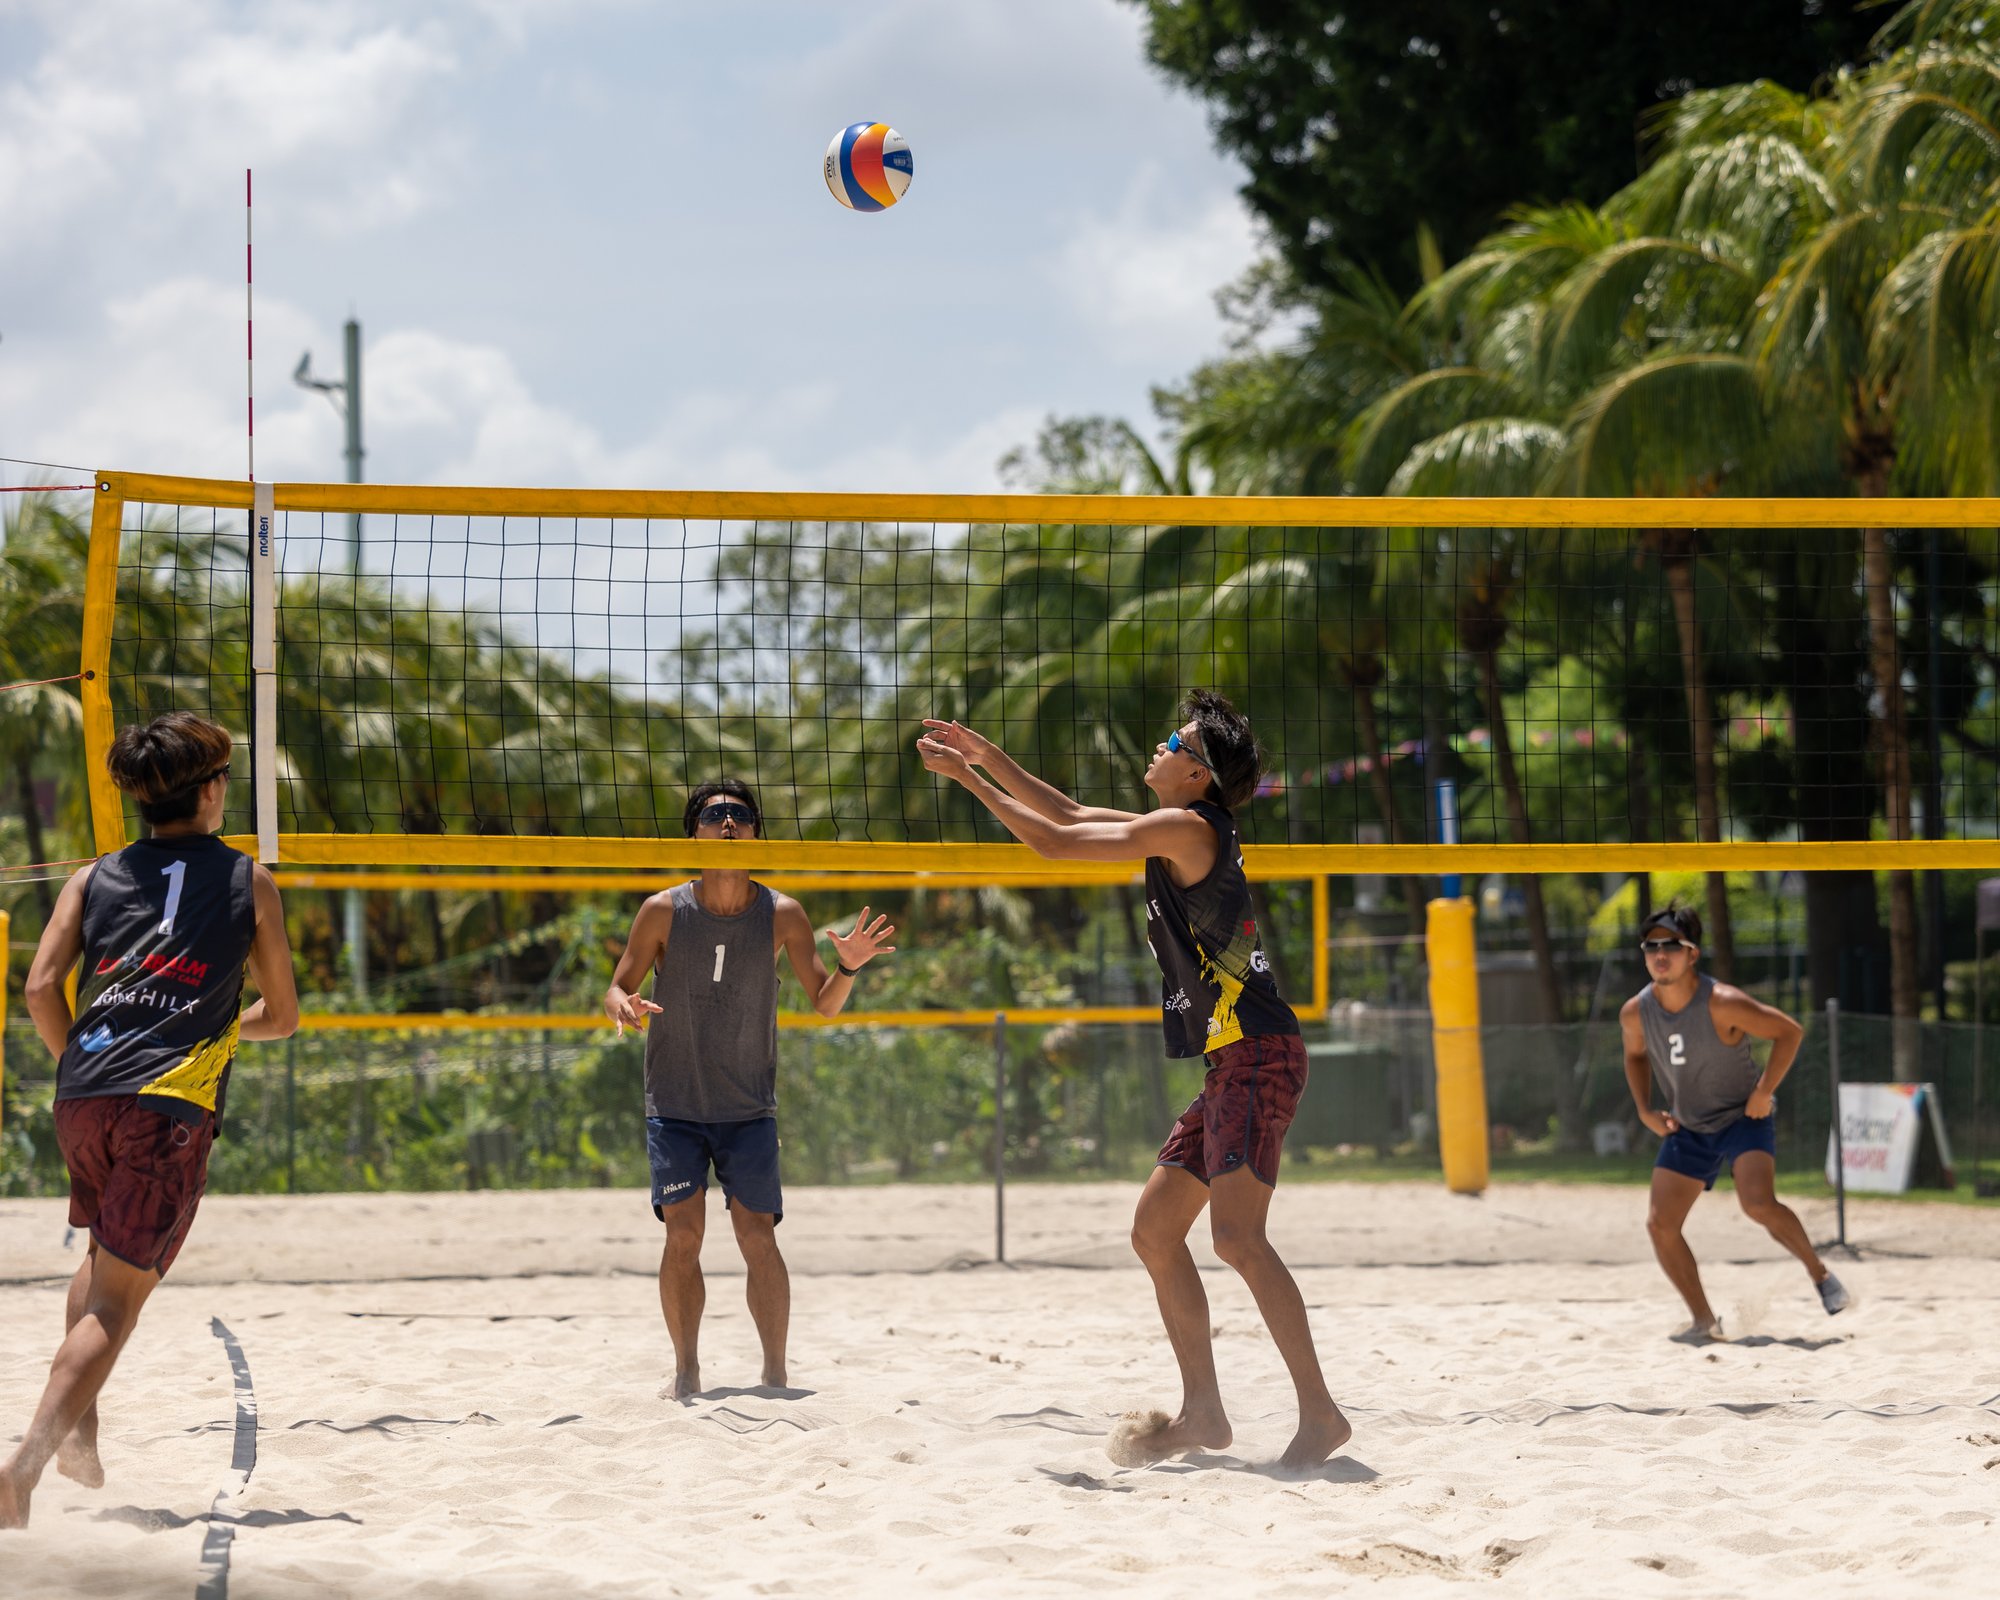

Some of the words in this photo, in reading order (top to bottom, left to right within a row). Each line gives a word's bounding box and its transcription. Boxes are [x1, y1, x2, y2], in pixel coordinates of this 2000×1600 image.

[258, 516, 269, 556] molten
[158, 860, 187, 936] 1
[713, 944, 726, 982] 1
[1668, 1033, 1686, 1065] 2
[663, 1180, 690, 1196] ATHLETA
